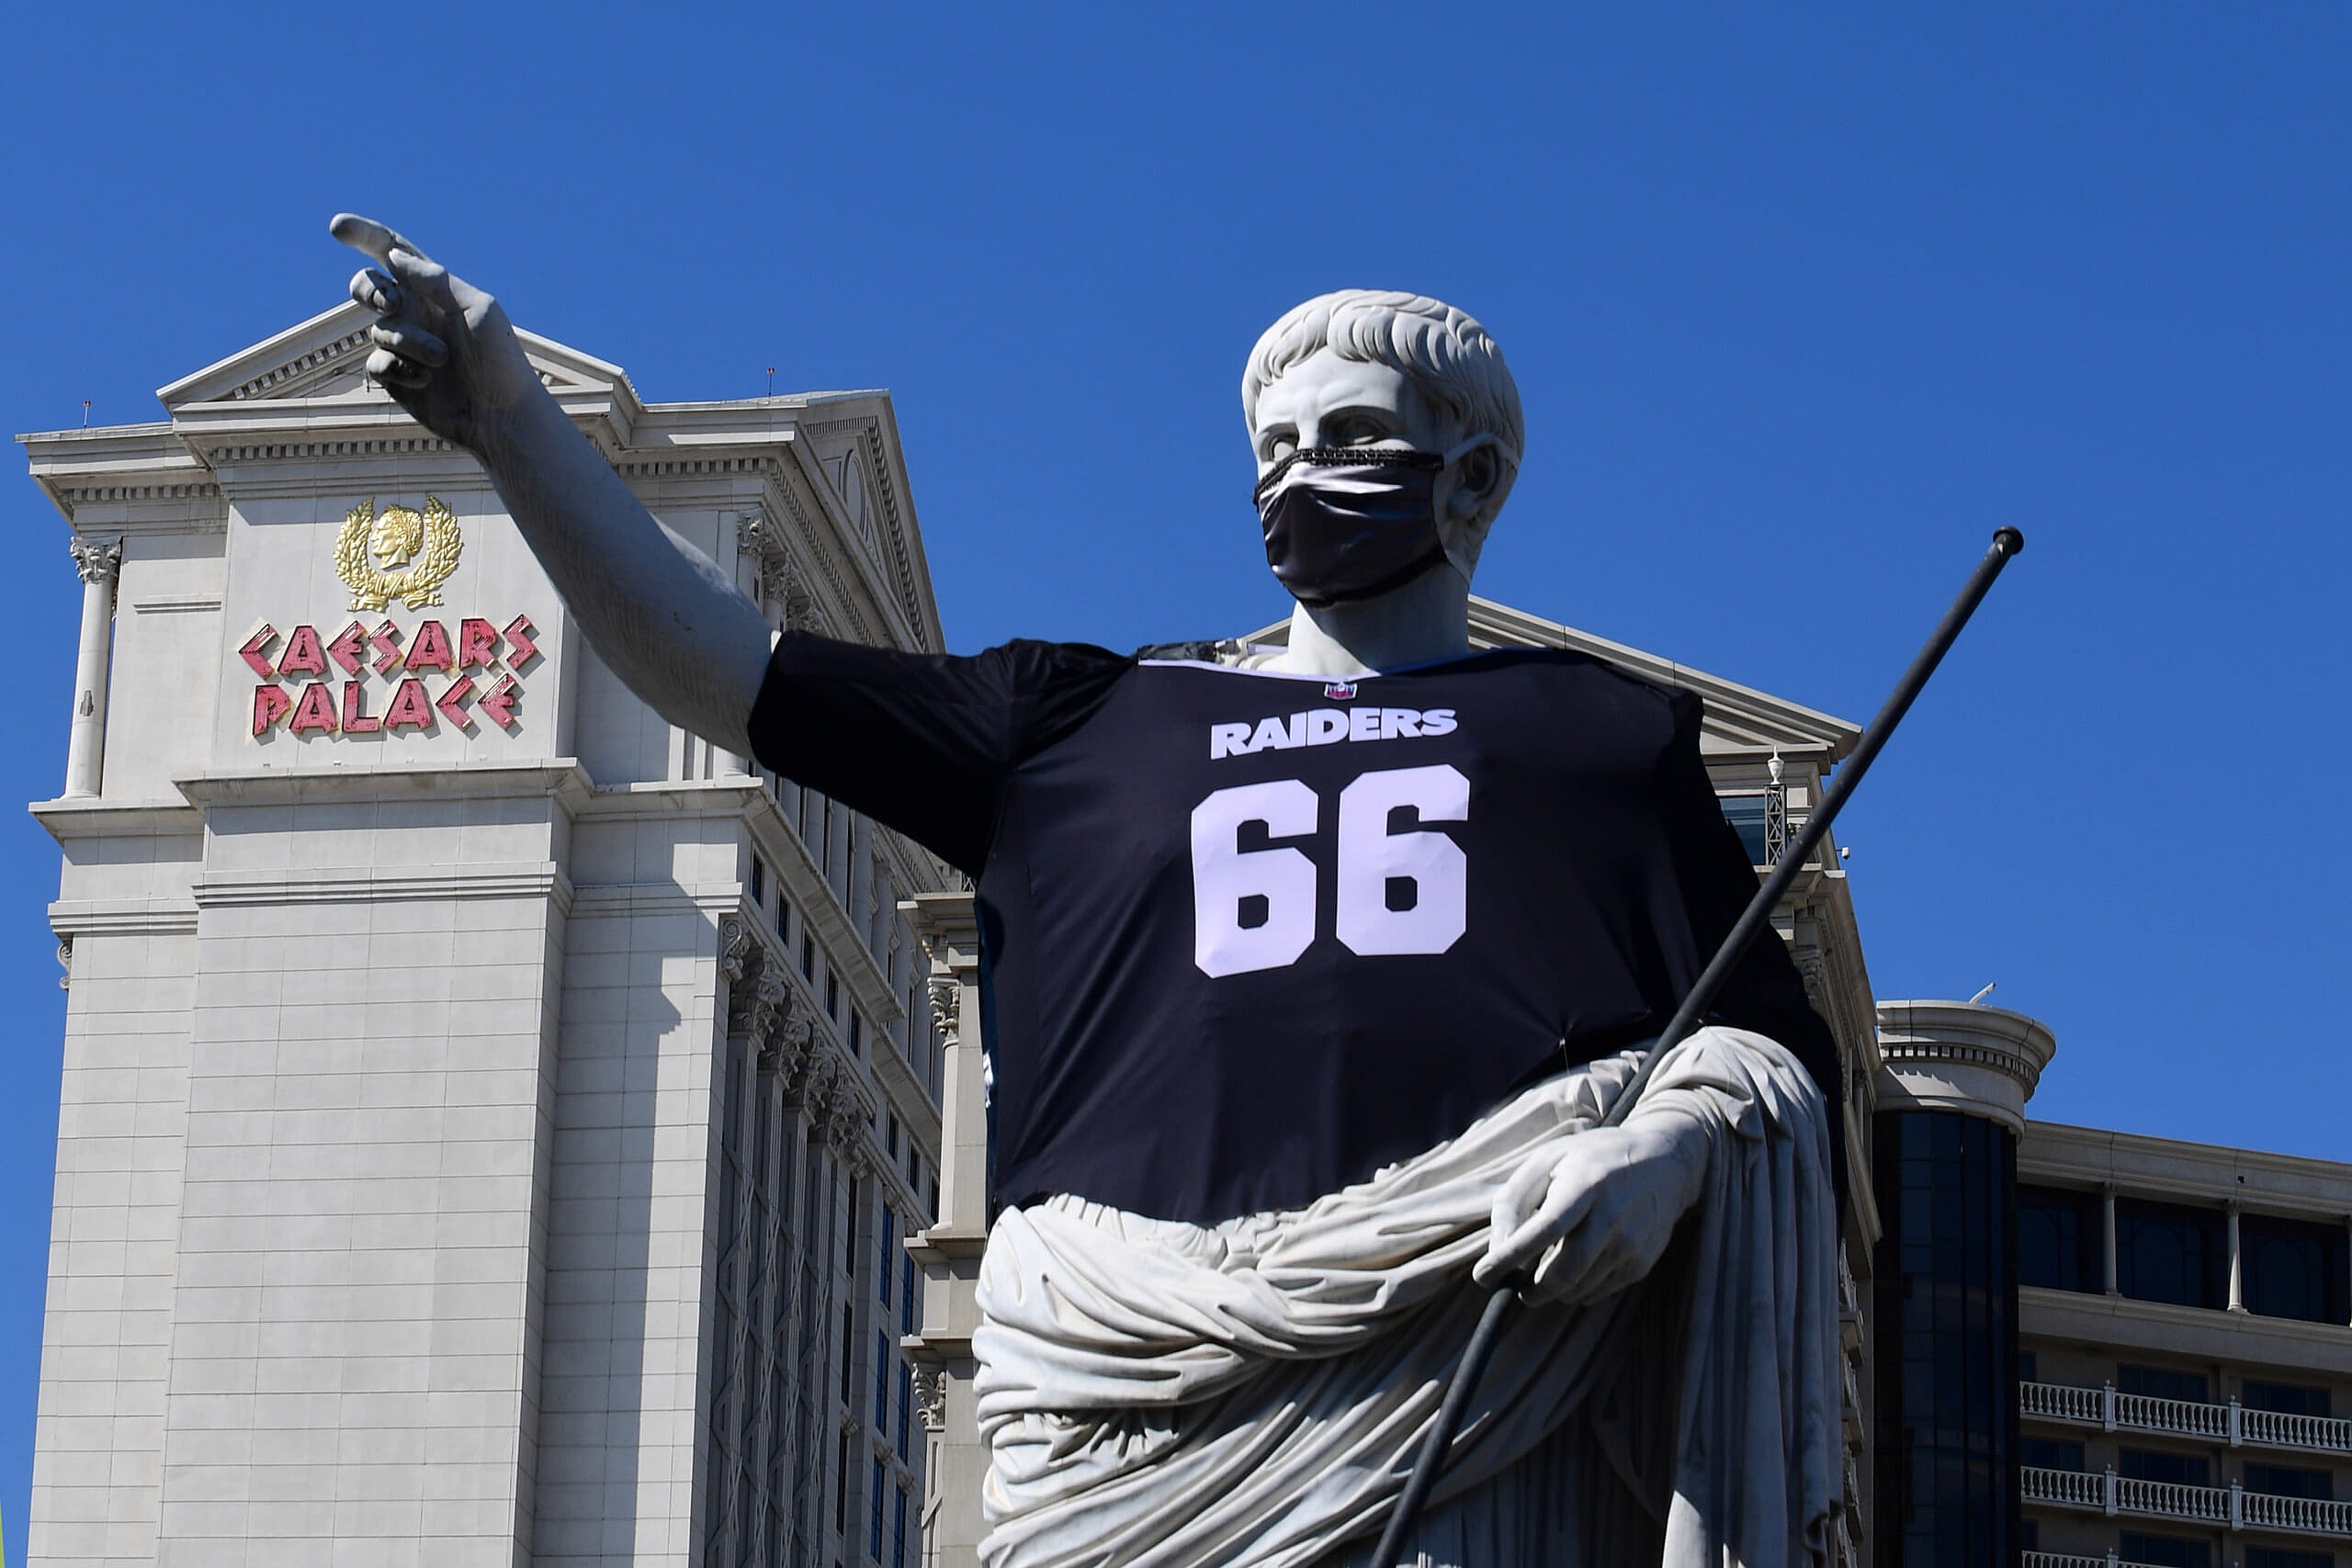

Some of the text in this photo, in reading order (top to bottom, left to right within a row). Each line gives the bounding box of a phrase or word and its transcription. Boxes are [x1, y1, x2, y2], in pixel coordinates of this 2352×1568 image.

[239, 614, 537, 678] CAESARS
[253, 672, 516, 736] PALACE
[1210, 706, 1459, 761] RAIDERS
[1191, 763, 1470, 979] 66
